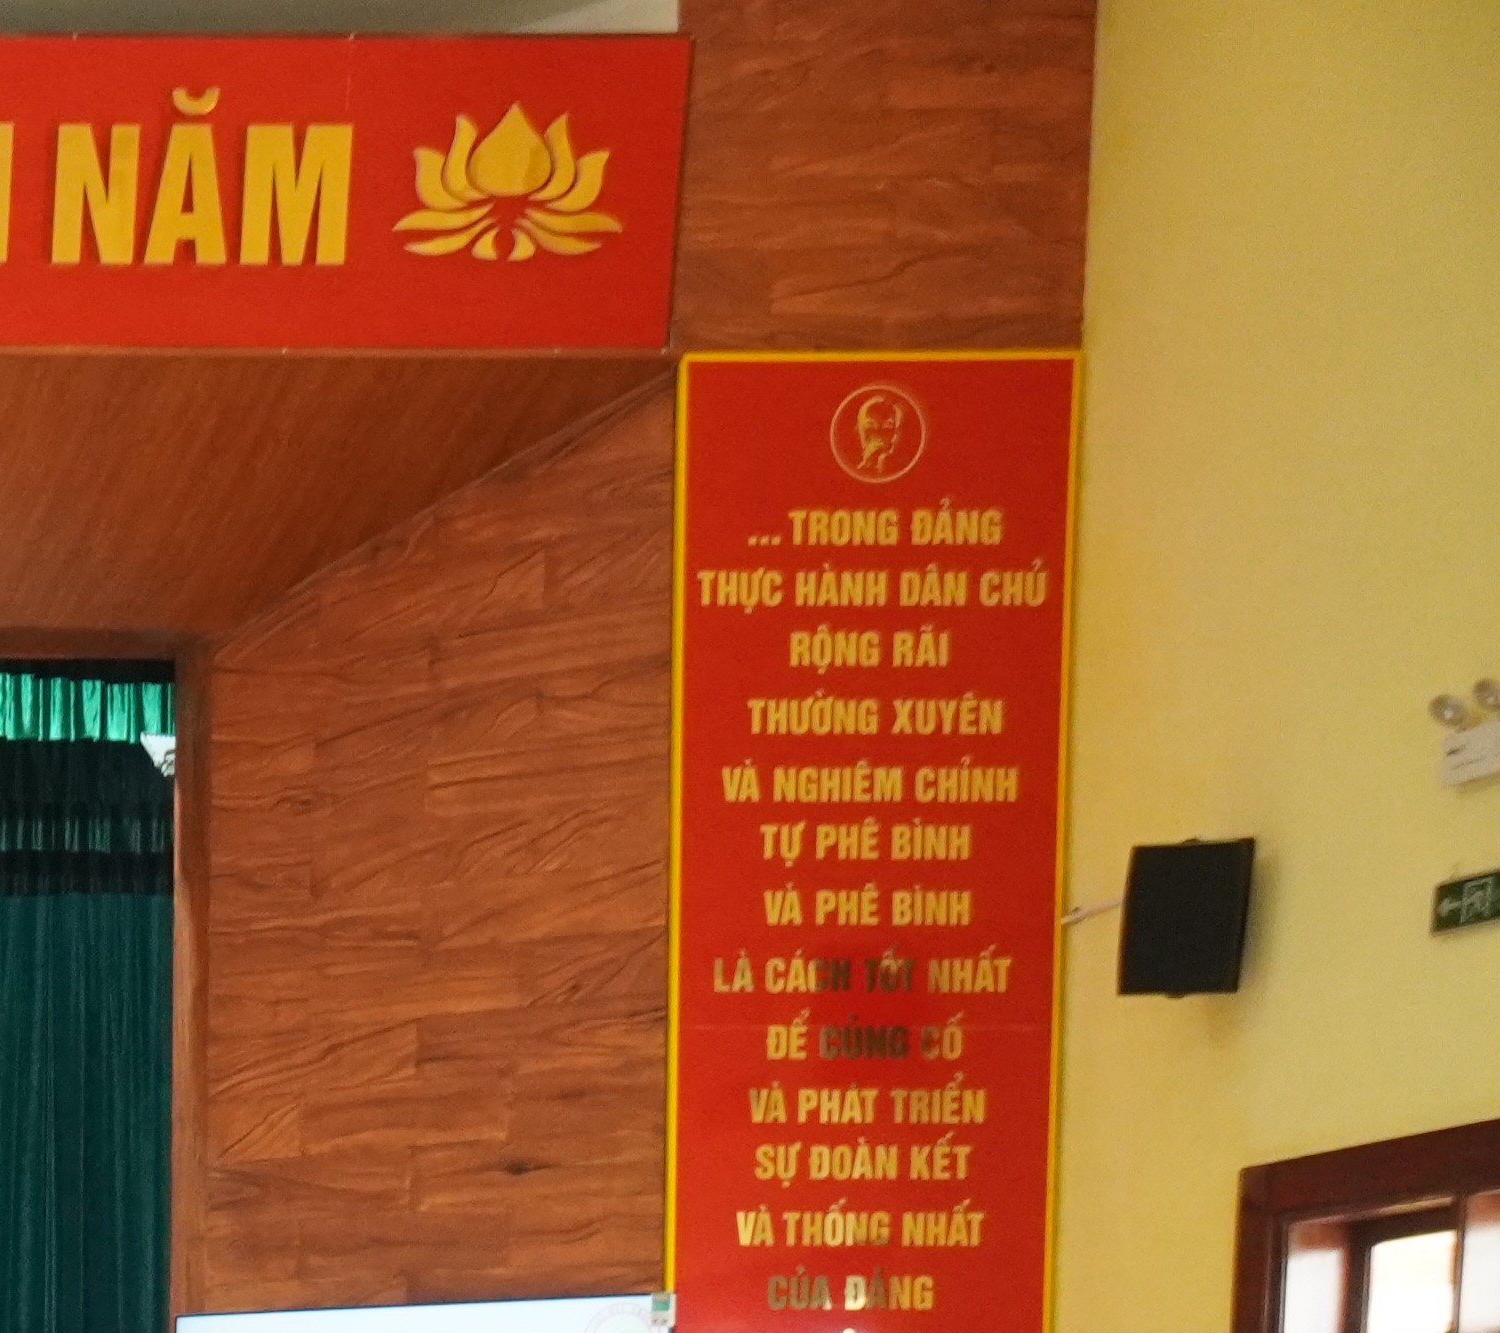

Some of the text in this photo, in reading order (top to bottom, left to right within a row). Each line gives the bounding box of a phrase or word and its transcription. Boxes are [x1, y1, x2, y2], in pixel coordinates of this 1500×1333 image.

[50, 87, 354, 269] NĂM
[788, 509, 898, 546] TRONG
[911, 498, 1002, 546] ĐẢNG
[697, 559, 1047, 614] THỰC HÀNH DÂN CHỦ
[789, 624, 950, 674] RỘNG RÃI
[748, 689, 1003, 735] THƯỜNG XUYÊN
[722, 754, 1018, 802] VÀ NGHIÊM CHỈNH
[760, 817, 971, 867] TỰ PHÊ BÌNH
[764, 882, 972, 926] VÀ PHÊ BÌNH
[713, 944, 1012, 993] LÀ CÁCH TỐT NHẤT
[766, 1009, 964, 1061] ĐỂ CỦNG CỐ
[749, 1072, 986, 1124] VÀ PHÁT TRIỂN
[754, 1131, 973, 1188] SỰ ĐOÀN KẾT
[736, 1198, 985, 1247] VÀ THỐNG NHẤT
[767, 1266, 934, 1311] CỦA ĐẢNG
